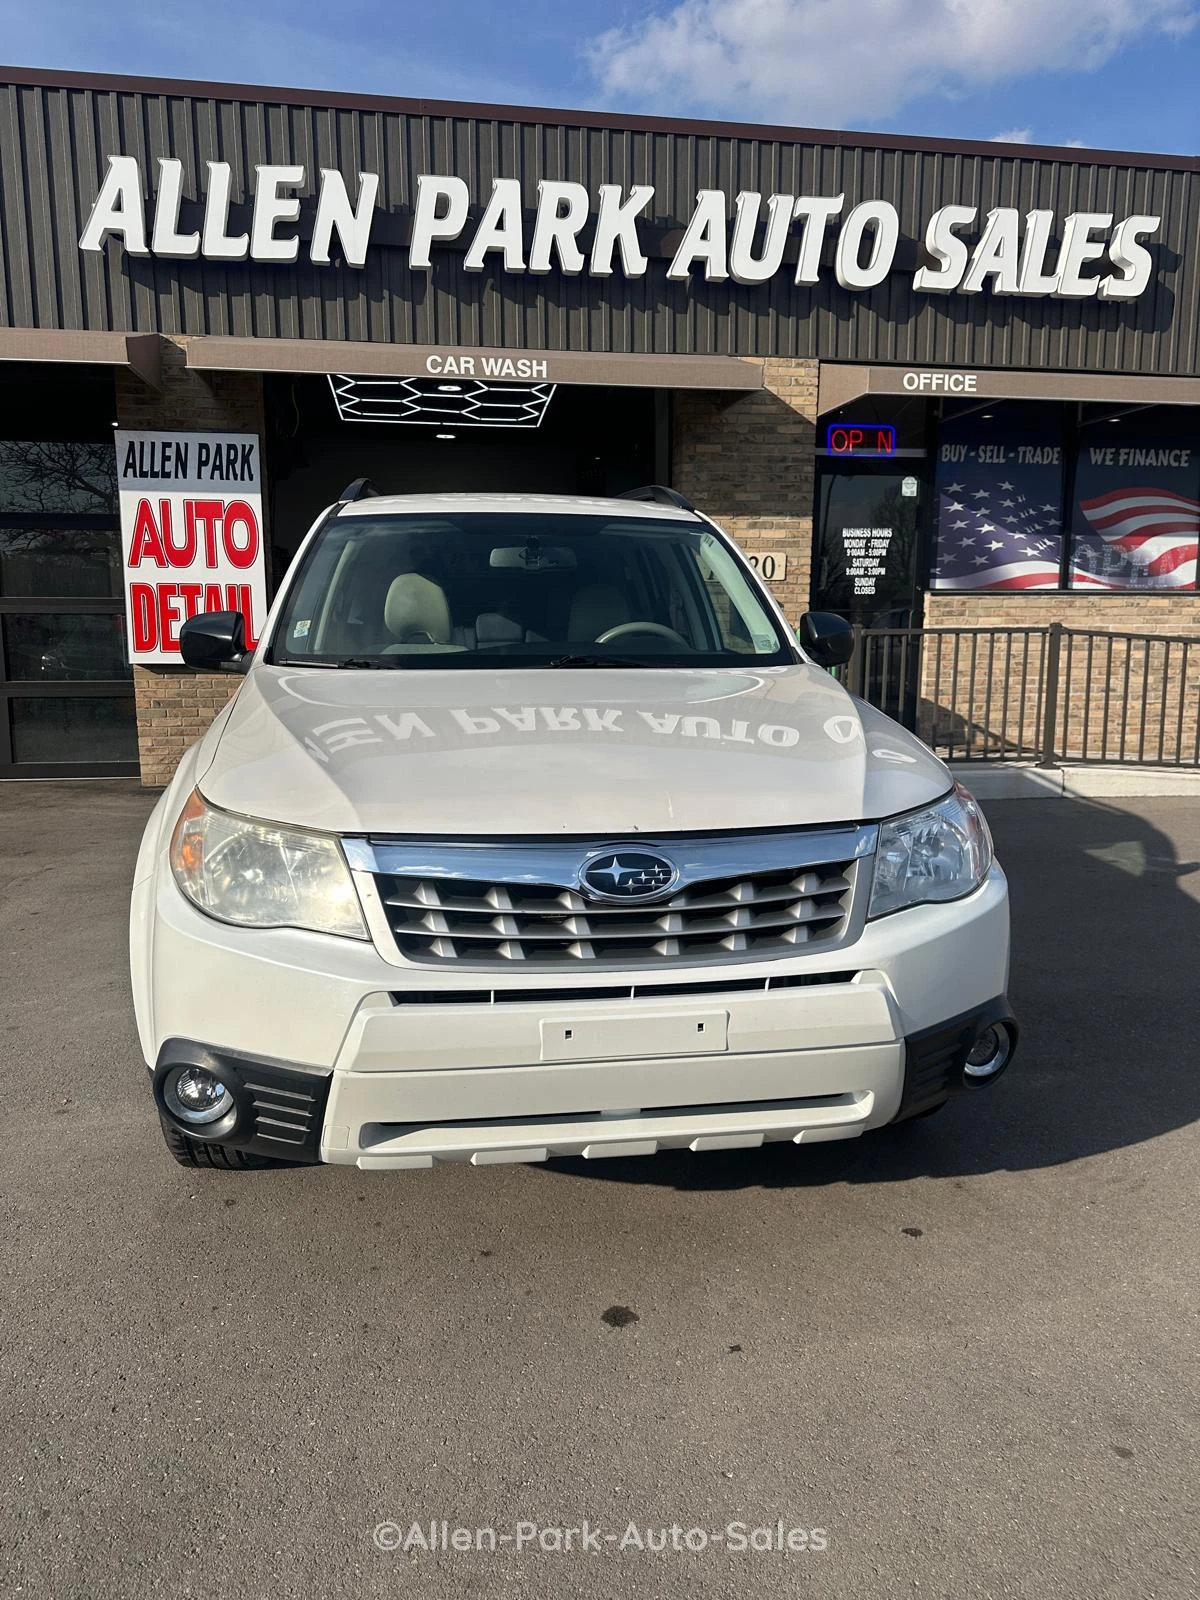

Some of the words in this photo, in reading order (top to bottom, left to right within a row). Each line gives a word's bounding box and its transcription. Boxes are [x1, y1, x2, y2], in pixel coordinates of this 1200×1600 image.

[78, 154, 379, 269] ALLEN
[408, 174, 655, 278] PARK
[666, 188, 899, 290] AUTO
[912, 203, 1161, 301] SALES
[426, 355, 475, 375] CAR
[481, 358, 548, 378] WASH
[902, 372, 977, 392] OFFICE
[831, 429, 892, 454] OPN
[122, 440, 189, 480] ALLEN
[196, 442, 255, 481] PARK
[941, 444, 968, 462] BUY
[978, 445, 1006, 464] SELL
[1018, 446, 1061, 465] TRADE
[1089, 447, 1116, 466] WE
[1119, 448, 1192, 468] FINANCE
[128, 498, 260, 569] AUTO
[842, 528, 871, 537] BUSINESS
[872, 528, 892, 537] HOURS
[844, 539, 866, 548] MONDAY
[871, 539, 890, 548] FRIDAY
[852, 558, 880, 567] SATURDAY
[854, 577, 876, 586] SUNDAY
